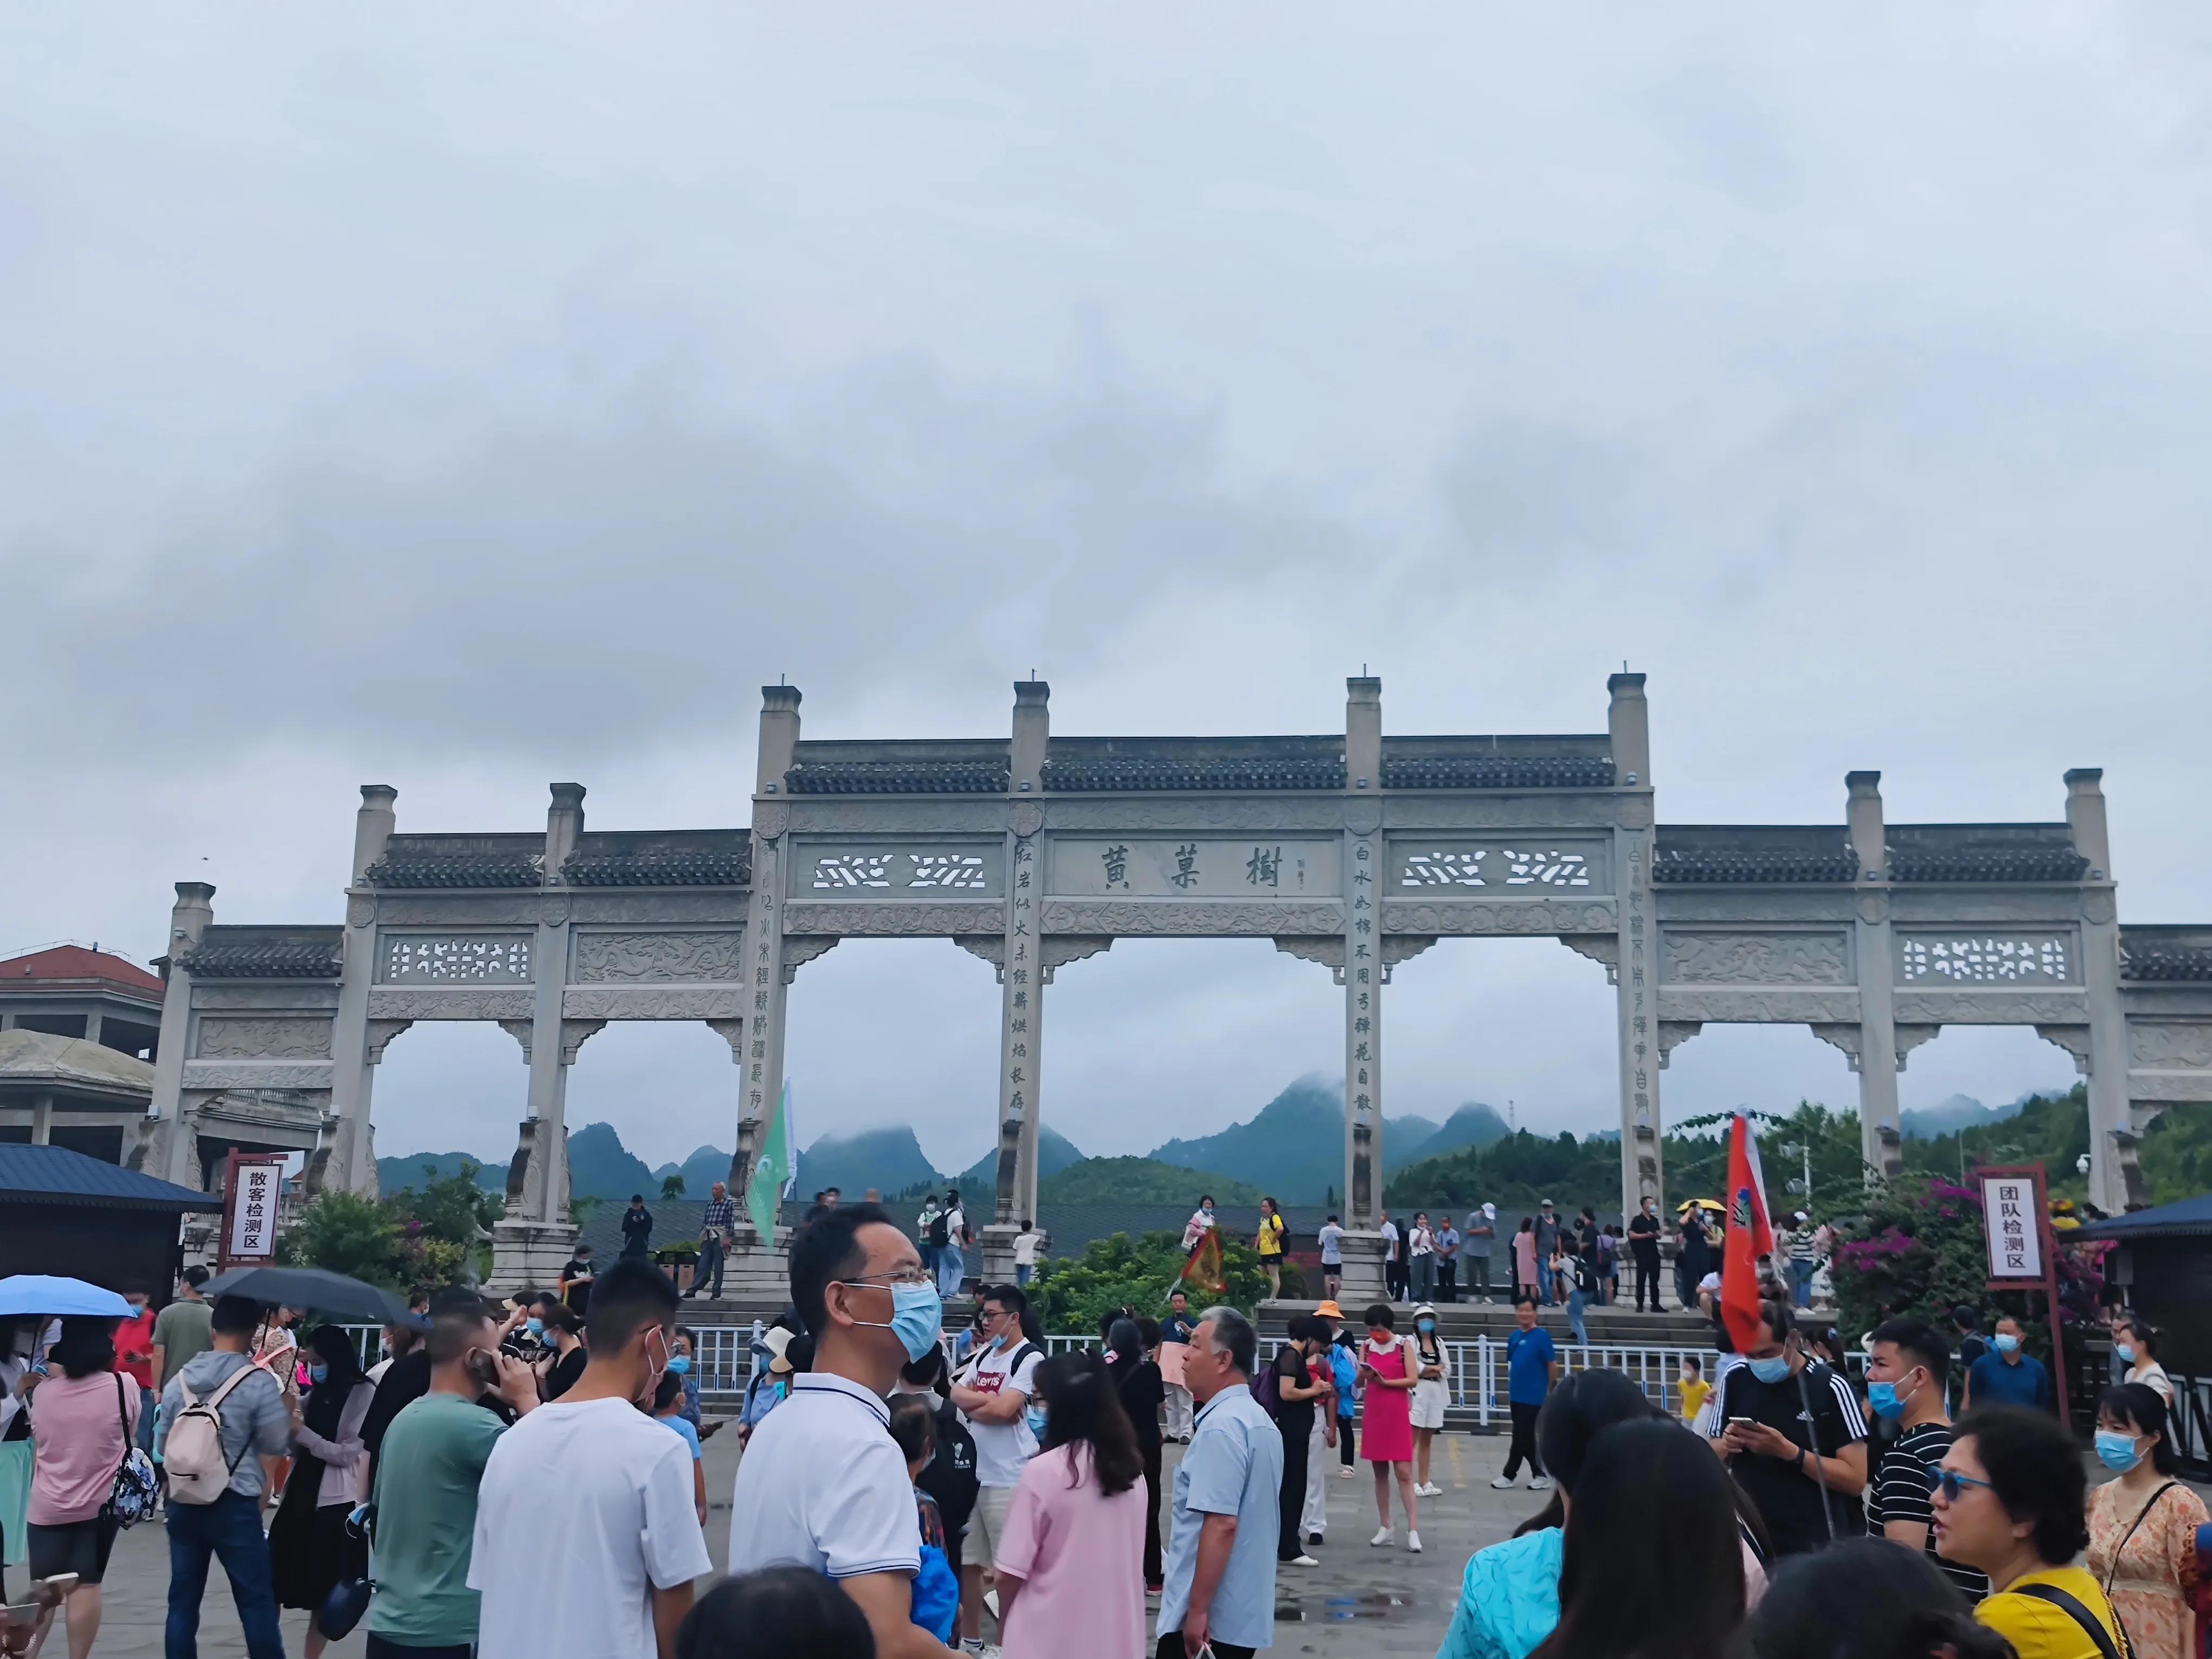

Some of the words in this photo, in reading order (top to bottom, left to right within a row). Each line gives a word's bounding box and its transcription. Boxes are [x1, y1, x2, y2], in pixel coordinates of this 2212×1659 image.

[243, 1172, 268, 1248] 散客检测区
[1999, 1186, 2026, 1268] 团队检测区
